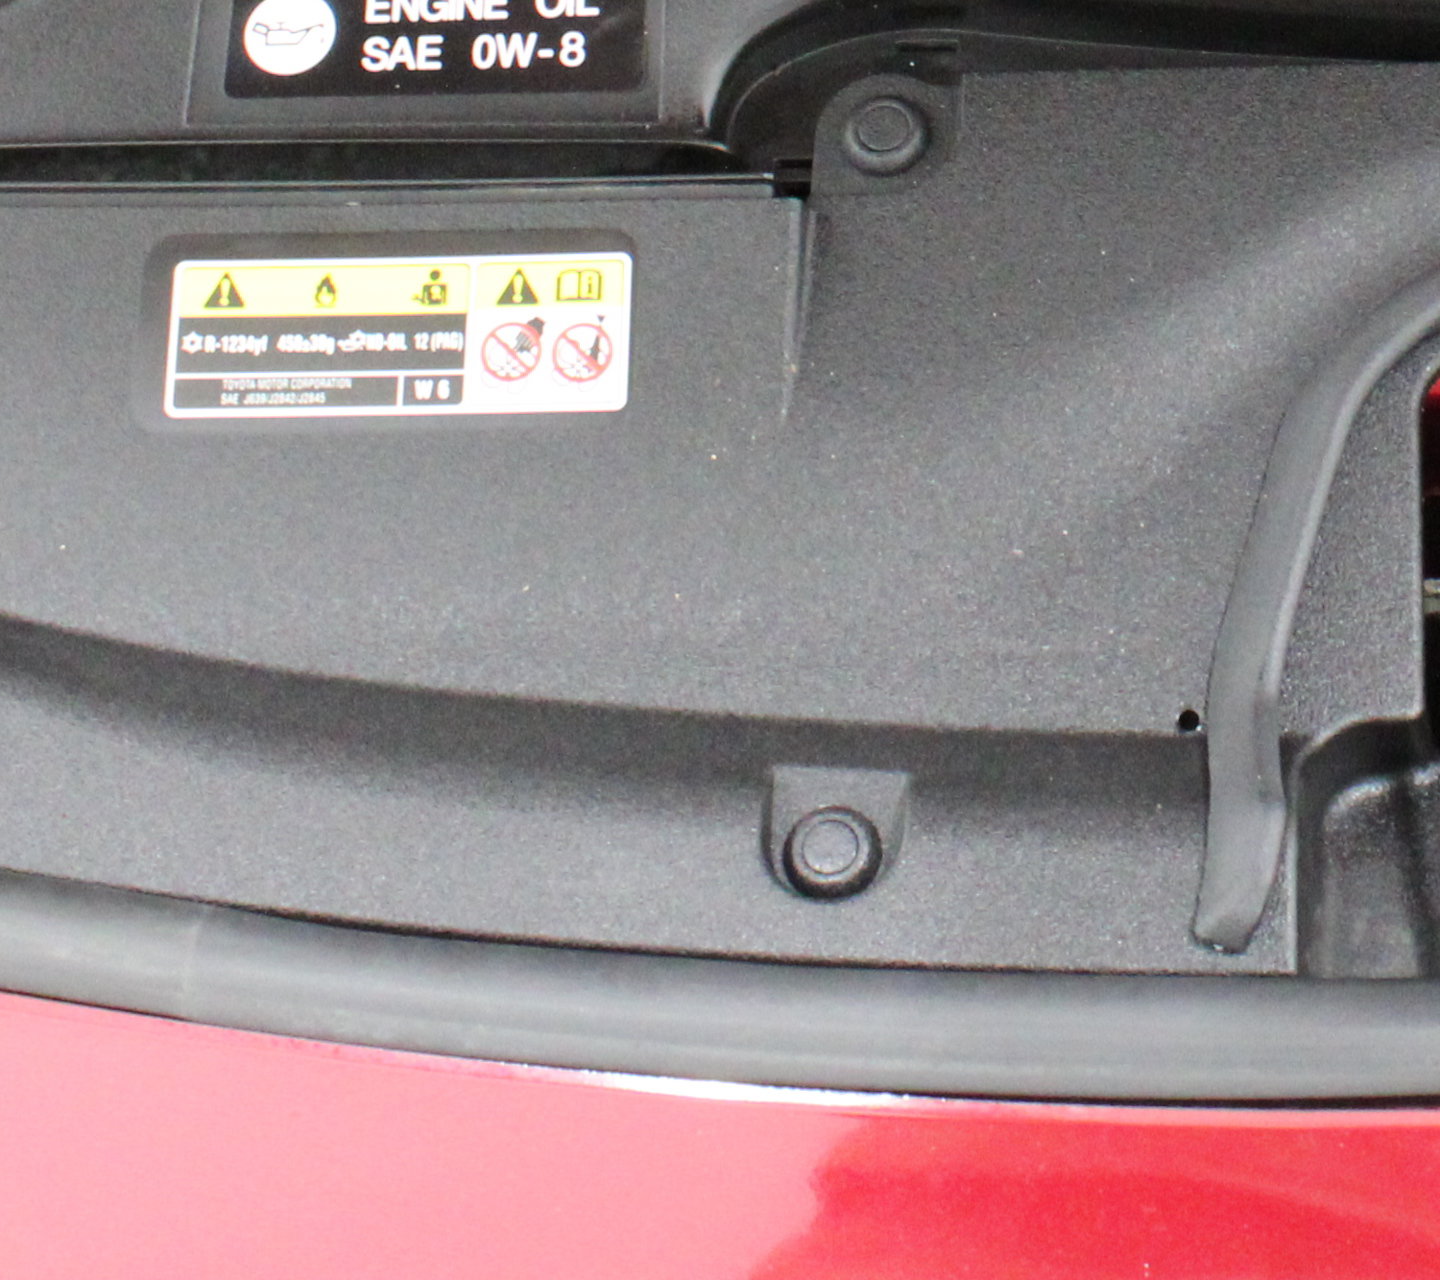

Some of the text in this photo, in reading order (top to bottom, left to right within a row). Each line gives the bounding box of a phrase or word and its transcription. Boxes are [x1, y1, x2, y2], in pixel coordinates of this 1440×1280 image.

[361, 31, 586, 73] SAE 0W-8
[204, 334, 268, 356] R-1234yf
[415, 332, 428, 350] 12
[431, 332, 464, 352] (PAG)
[222, 377, 352, 391] TOYOTA MOTOR CORPORATION
[414, 379, 451, 399] W 6
[221, 392, 239, 405] SAE
